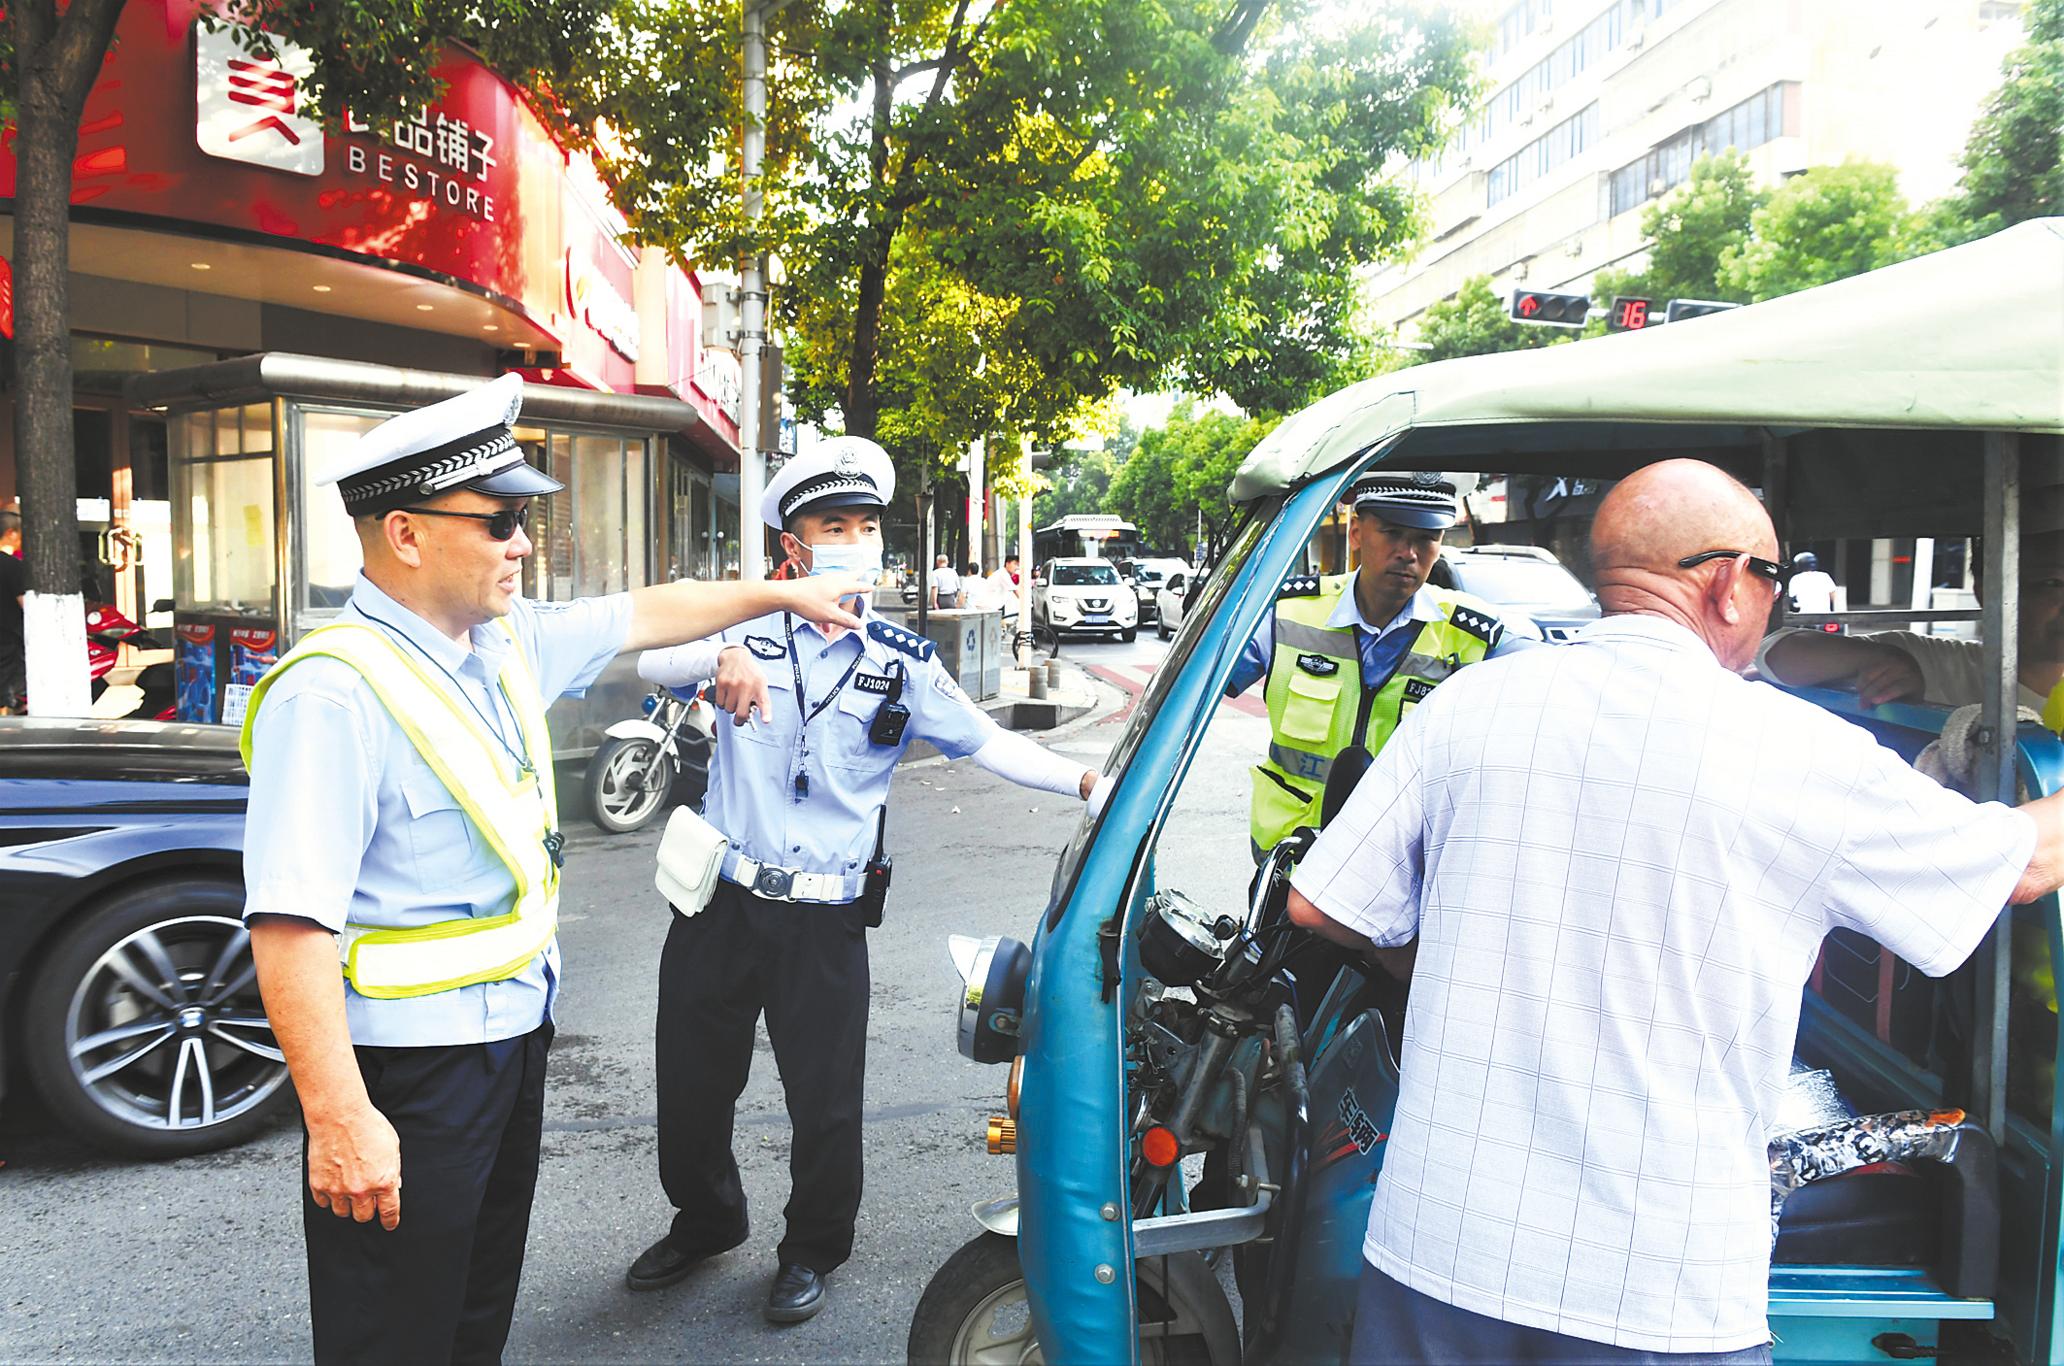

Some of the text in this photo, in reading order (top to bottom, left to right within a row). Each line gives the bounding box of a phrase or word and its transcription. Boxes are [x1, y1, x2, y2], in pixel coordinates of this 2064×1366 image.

[347, 103, 497, 182] 品铺子
[348, 145, 495, 222] BESTORE
[1621, 301, 1647, 329] 16
[825, 686, 841, 704] POLICE
[857, 675, 890, 691] FJ1024
[1338, 1087, 1380, 1155] 车辆
